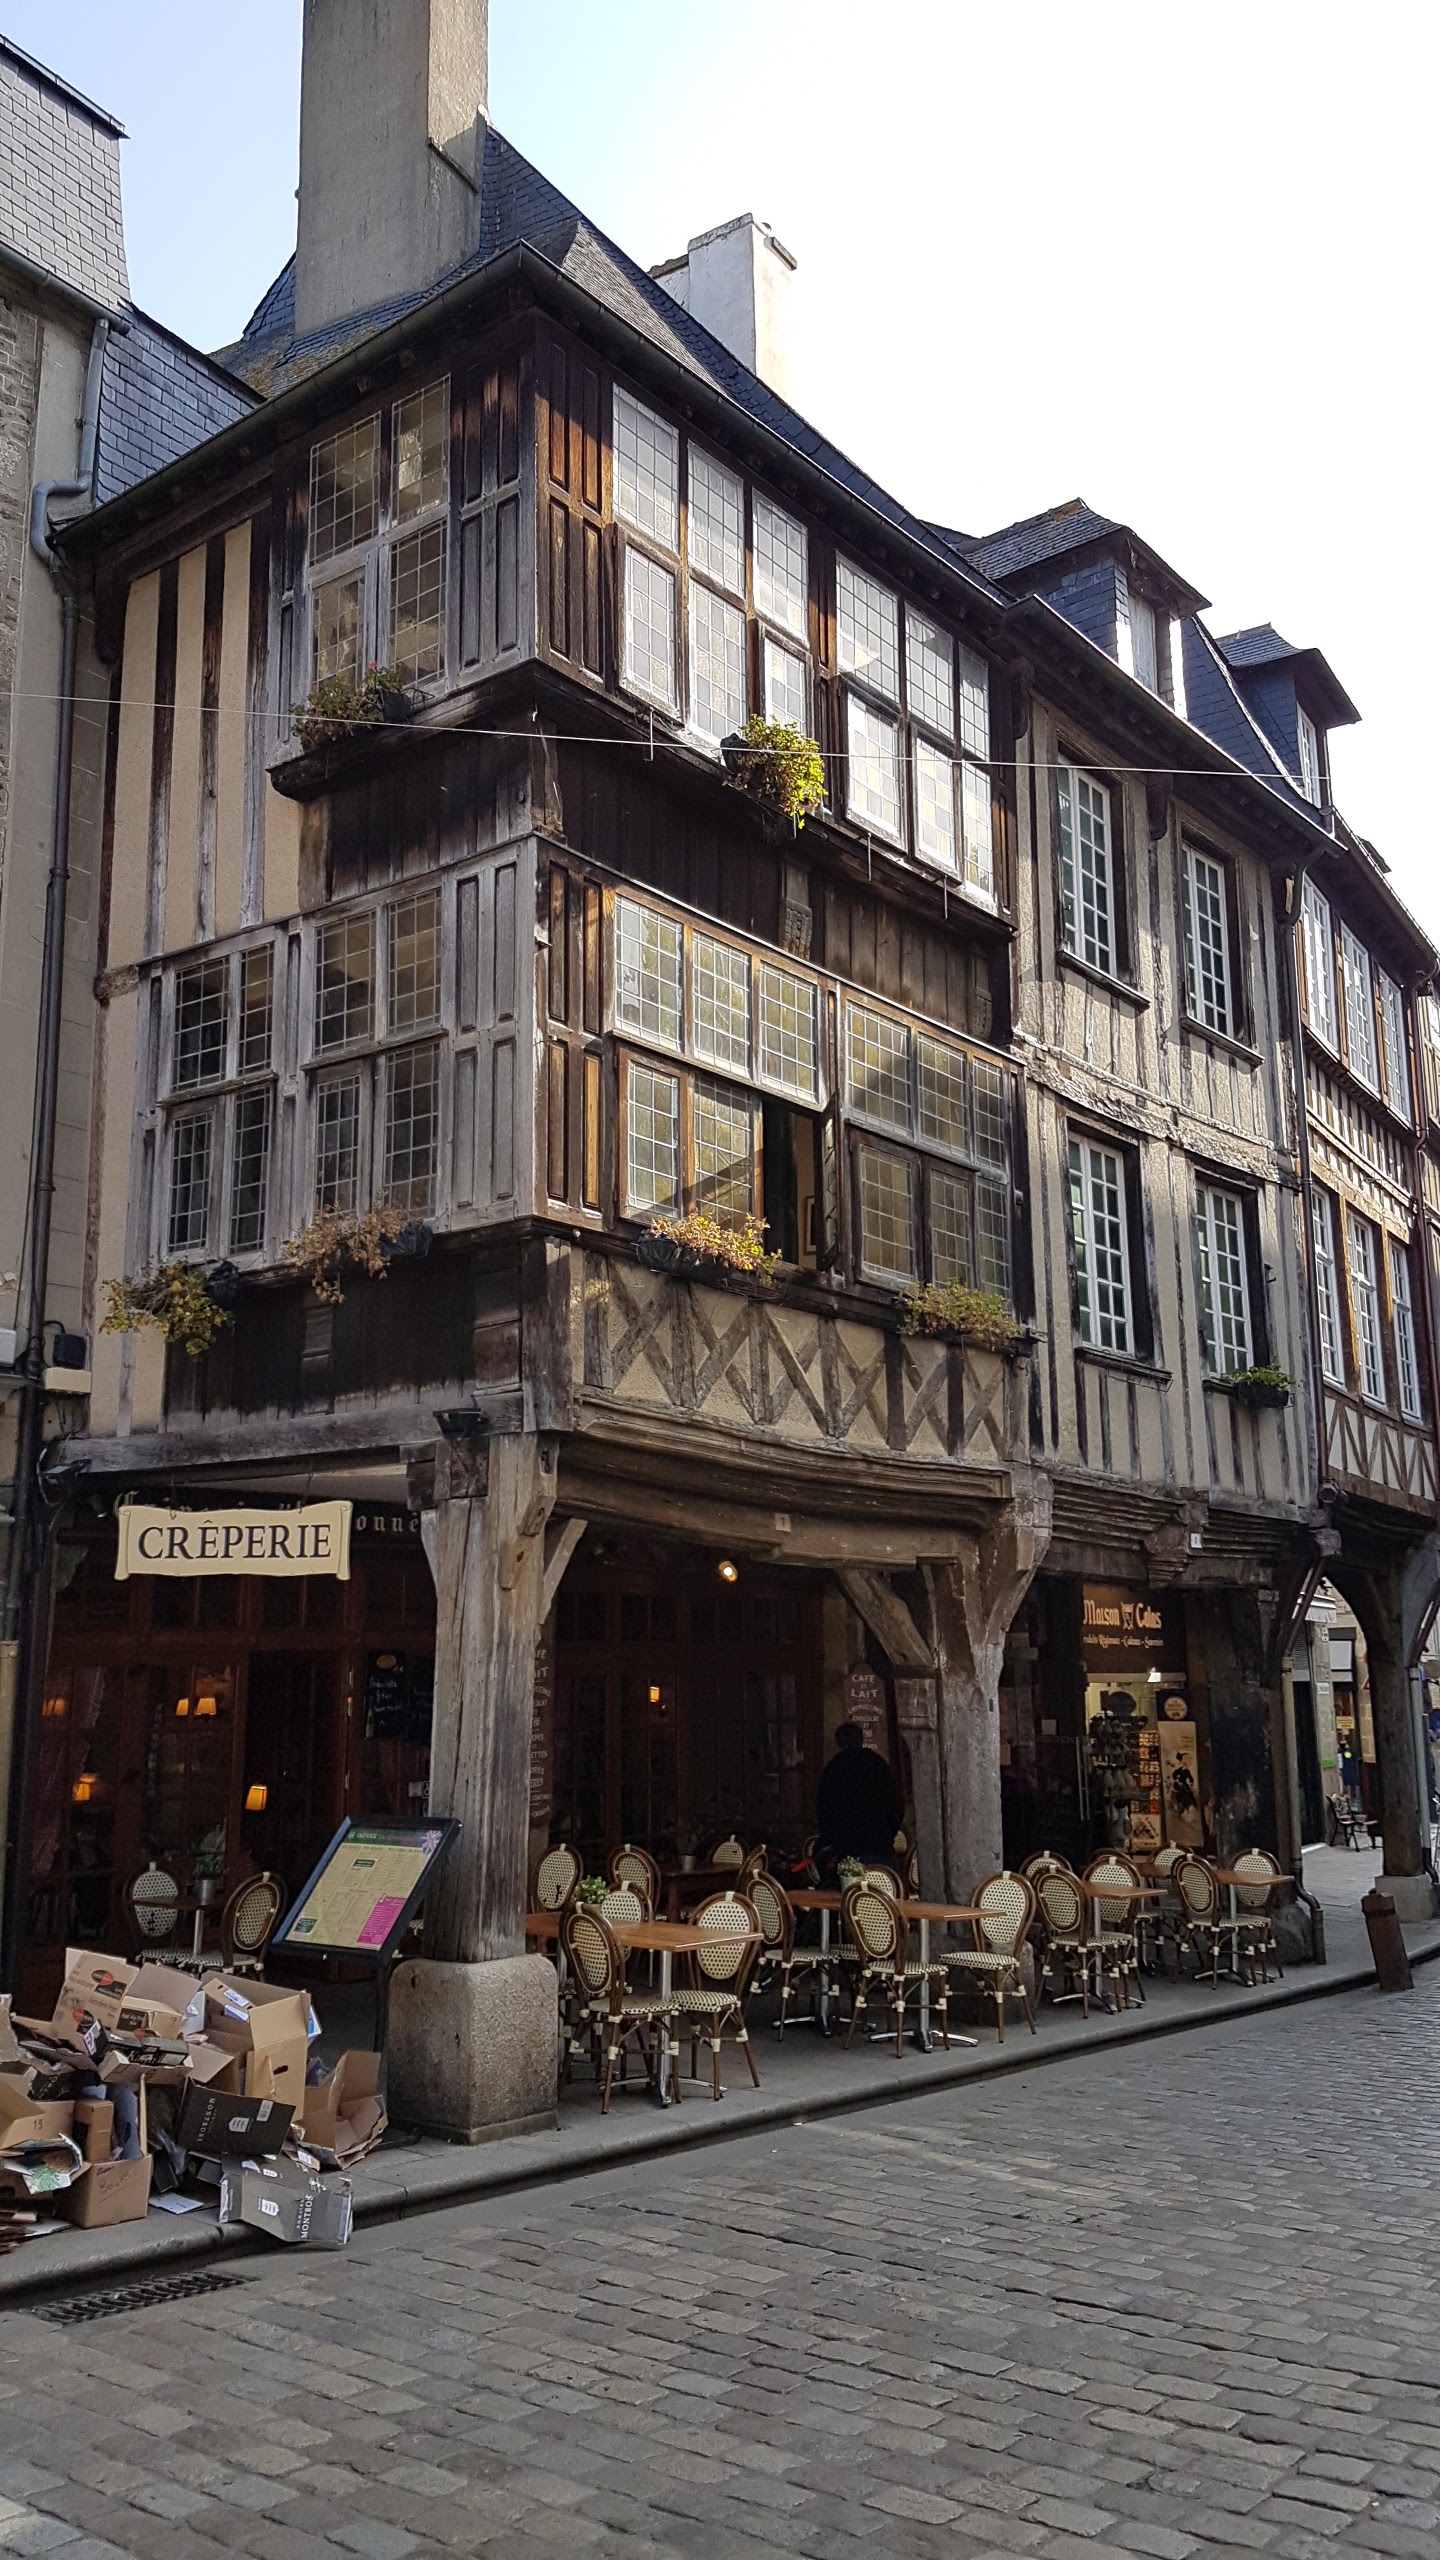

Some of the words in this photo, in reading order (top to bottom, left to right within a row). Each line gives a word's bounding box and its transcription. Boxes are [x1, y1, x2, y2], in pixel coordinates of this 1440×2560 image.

[137, 1519, 332, 1560] CRÊPERIE
[1083, 1599, 1121, 1626] Maison
[850, 1688, 879, 1698] LAIT
[32, 2118, 44, 2131] 15
